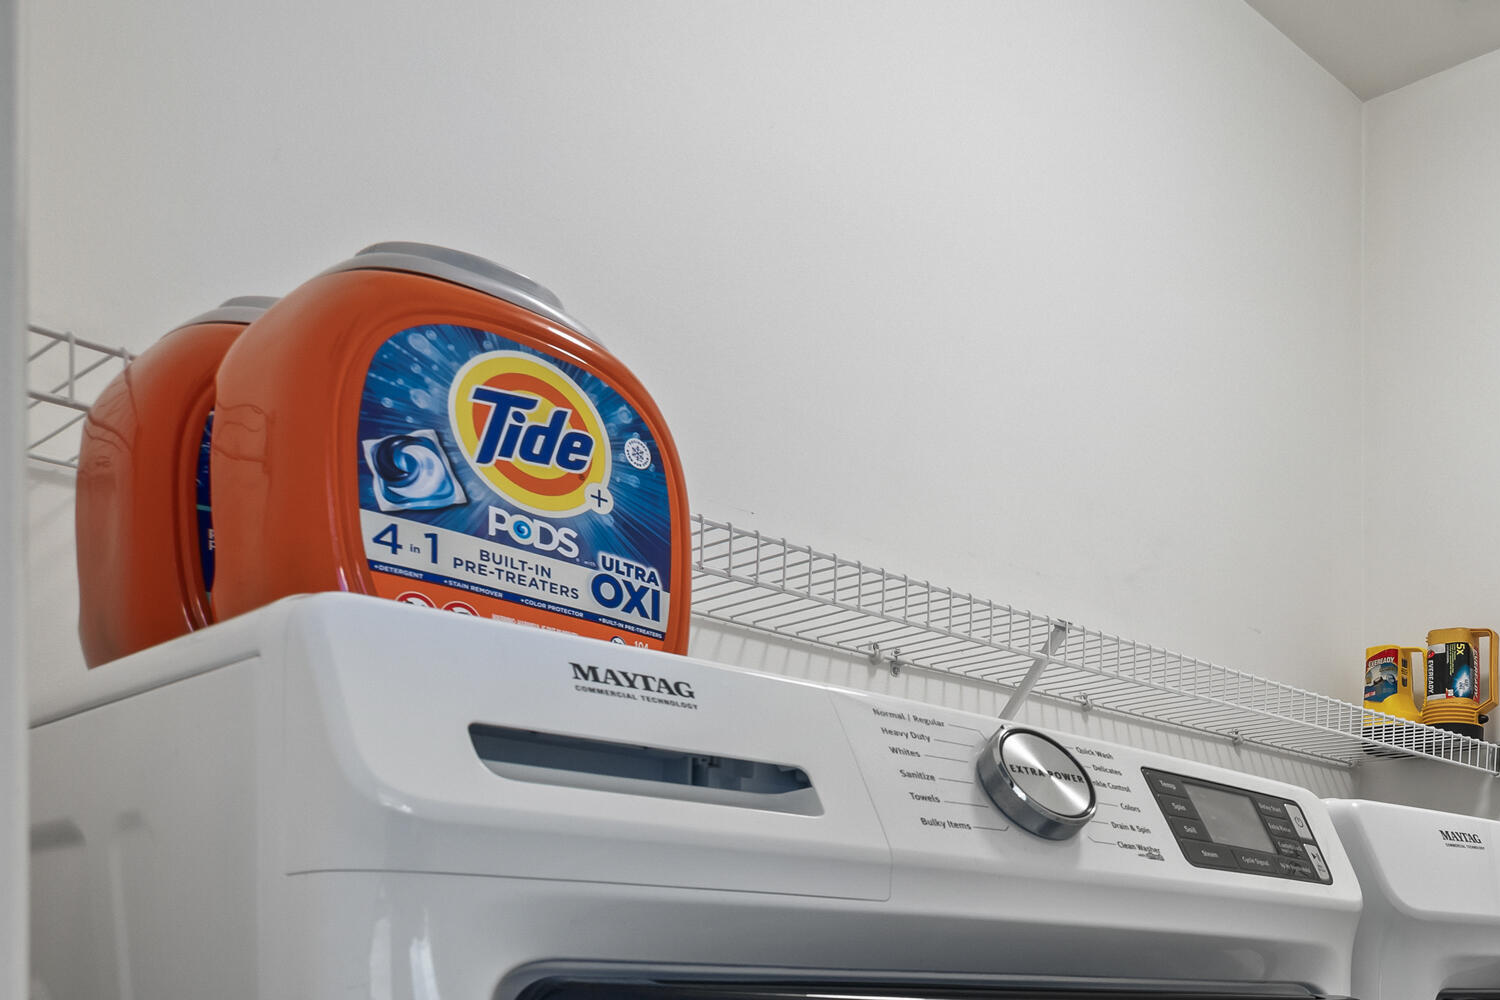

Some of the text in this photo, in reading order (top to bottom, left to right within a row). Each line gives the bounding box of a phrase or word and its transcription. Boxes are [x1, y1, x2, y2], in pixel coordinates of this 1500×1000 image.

[472, 386, 594, 471] Tide
[488, 506, 580, 558] PODS
[372, 523, 438, 564] 4 in 1
[479, 549, 552, 579] BUILT-IN
[601, 555, 659, 587] ULTRA
[453, 557, 579, 600] PRE-TREATERS
[448, 580, 503, 599] STAIN REMOVER
[591, 573, 660, 622] OXI
[524, 599, 584, 619] COLOR PROTECTOR
[568, 662, 696, 699] MAYTAG
[574, 685, 698, 710] COMMERCIAL TECHNOLOGY
[872, 707, 905, 721] Normal
[912, 715, 945, 727] Regular
[880, 727, 931, 743] Heavy Duty
[888, 746, 921, 757] Whites
[1076, 746, 1114, 760] Quick Wash
[899, 769, 936, 782] Sanitize
[1009, 764, 1085, 784] EXTRA POWER
[1092, 764, 1122, 776] Delicates
[1108, 782, 1131, 793] Control
[909, 792, 941, 803] Towels
[1120, 803, 1141, 813] Colors
[920, 817, 972, 830] Bulky Items
[1111, 821, 1131, 831] Drain
[1117, 841, 1136, 850] Clean
[1438, 829, 1482, 844] MAYTAG
